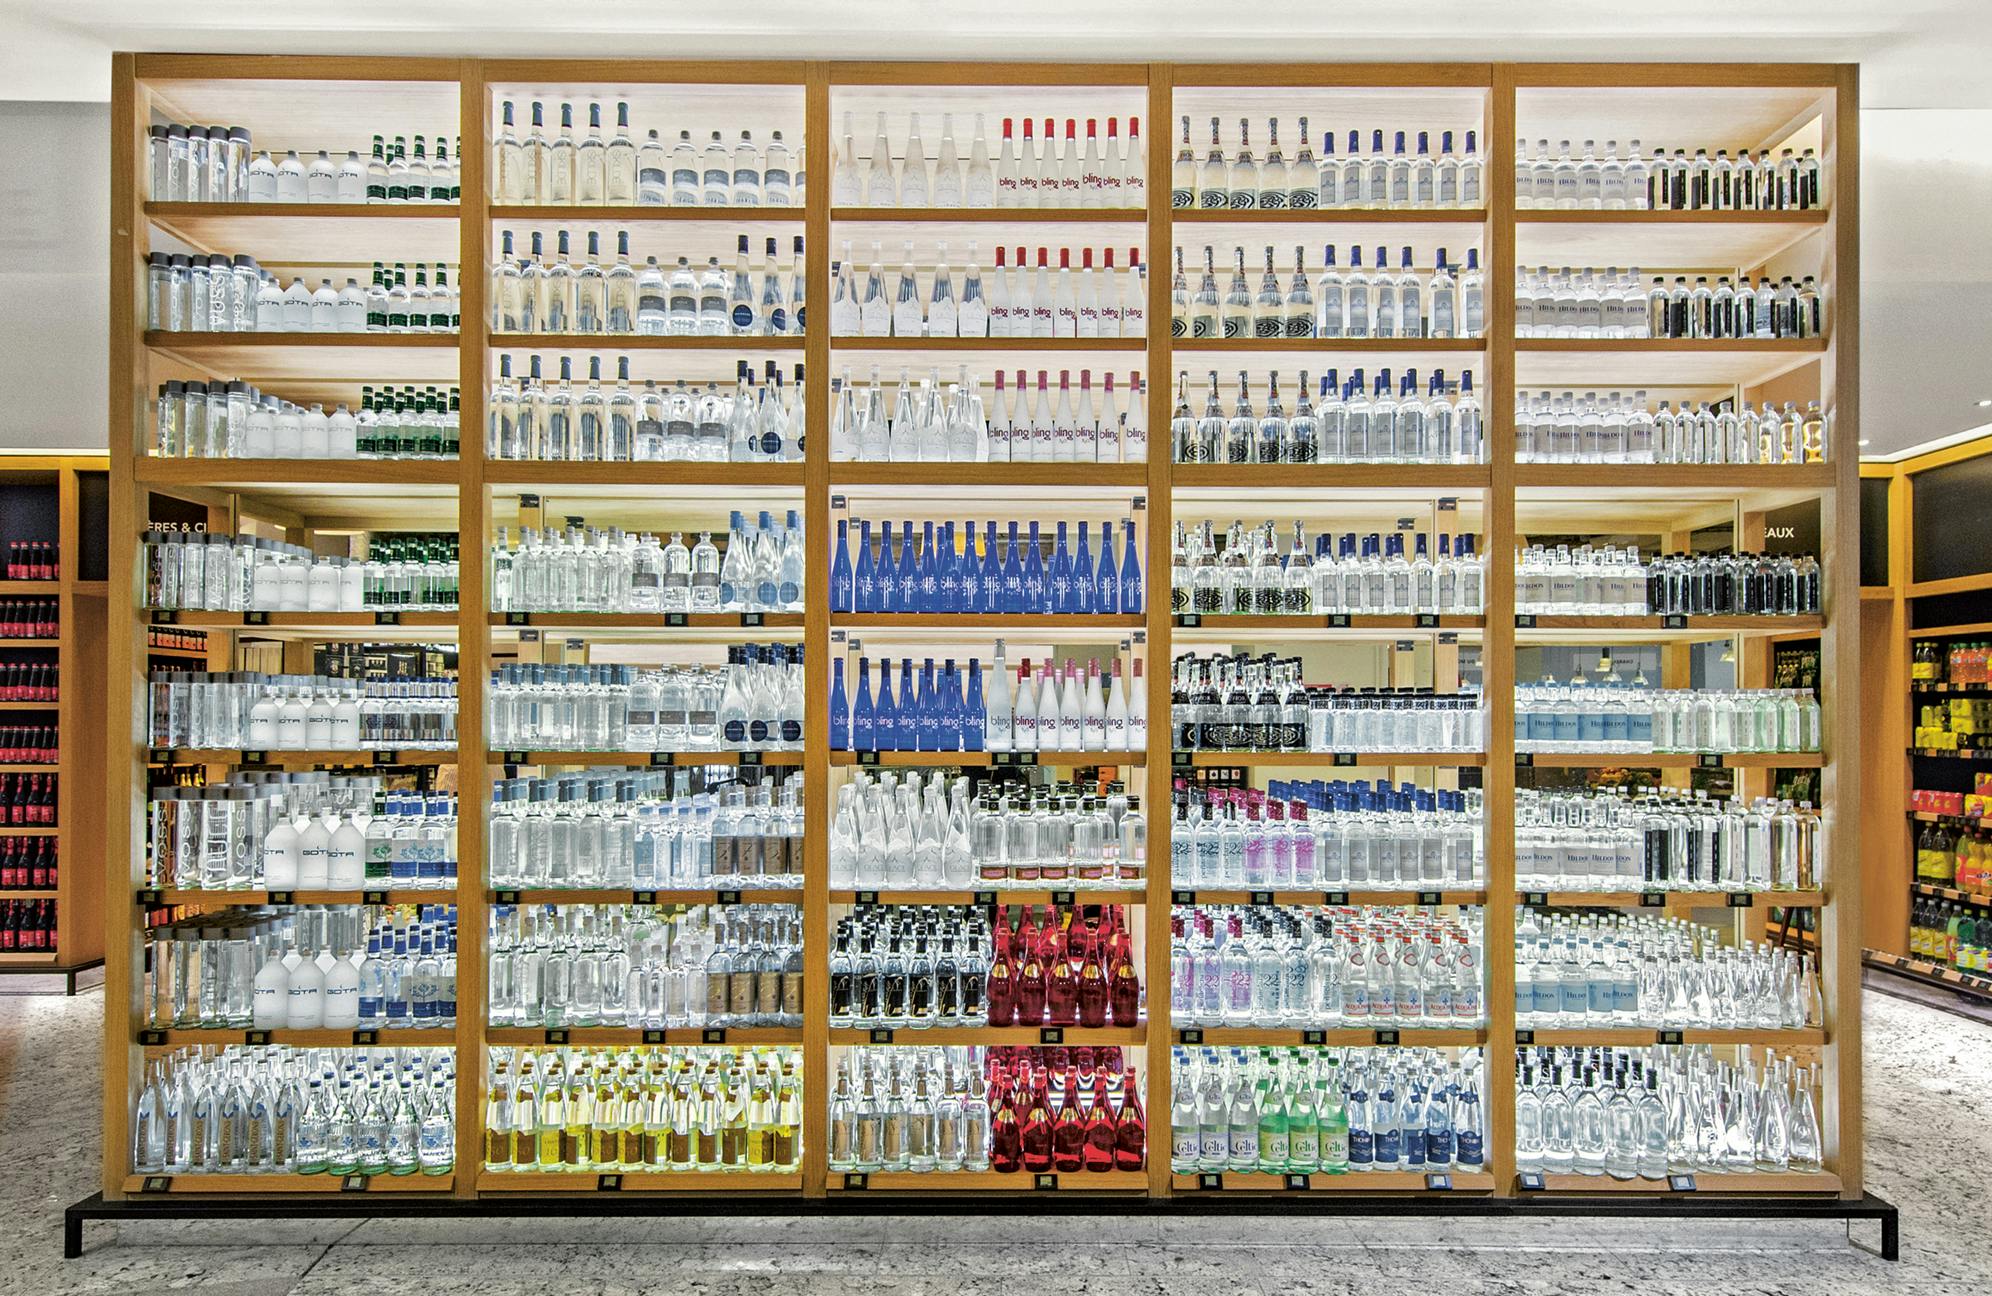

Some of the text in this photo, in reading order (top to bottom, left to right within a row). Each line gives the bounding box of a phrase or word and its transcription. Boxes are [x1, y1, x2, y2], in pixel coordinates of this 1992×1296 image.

[1000, 177, 1016, 189] bling
[1020, 177, 1037, 188] bling
[1042, 177, 1058, 189] bling
[1062, 178, 1079, 189] bling
[1083, 173, 1102, 188] bling
[1104, 176, 1120, 187] bling
[1127, 176, 1143, 188] bling
[991, 306, 1008, 317] bling
[1013, 307, 1029, 317] bling
[1034, 307, 1051, 318] bling
[1081, 308, 1097, 319] bling
[1102, 308, 1118, 319] bling
[1126, 308, 1142, 318] bling
[181, 522, 190, 533] &
[1016, 716, 1035, 729] bling
[236, 808, 246, 875] VOSS
[327, 986, 357, 995] GOTA
